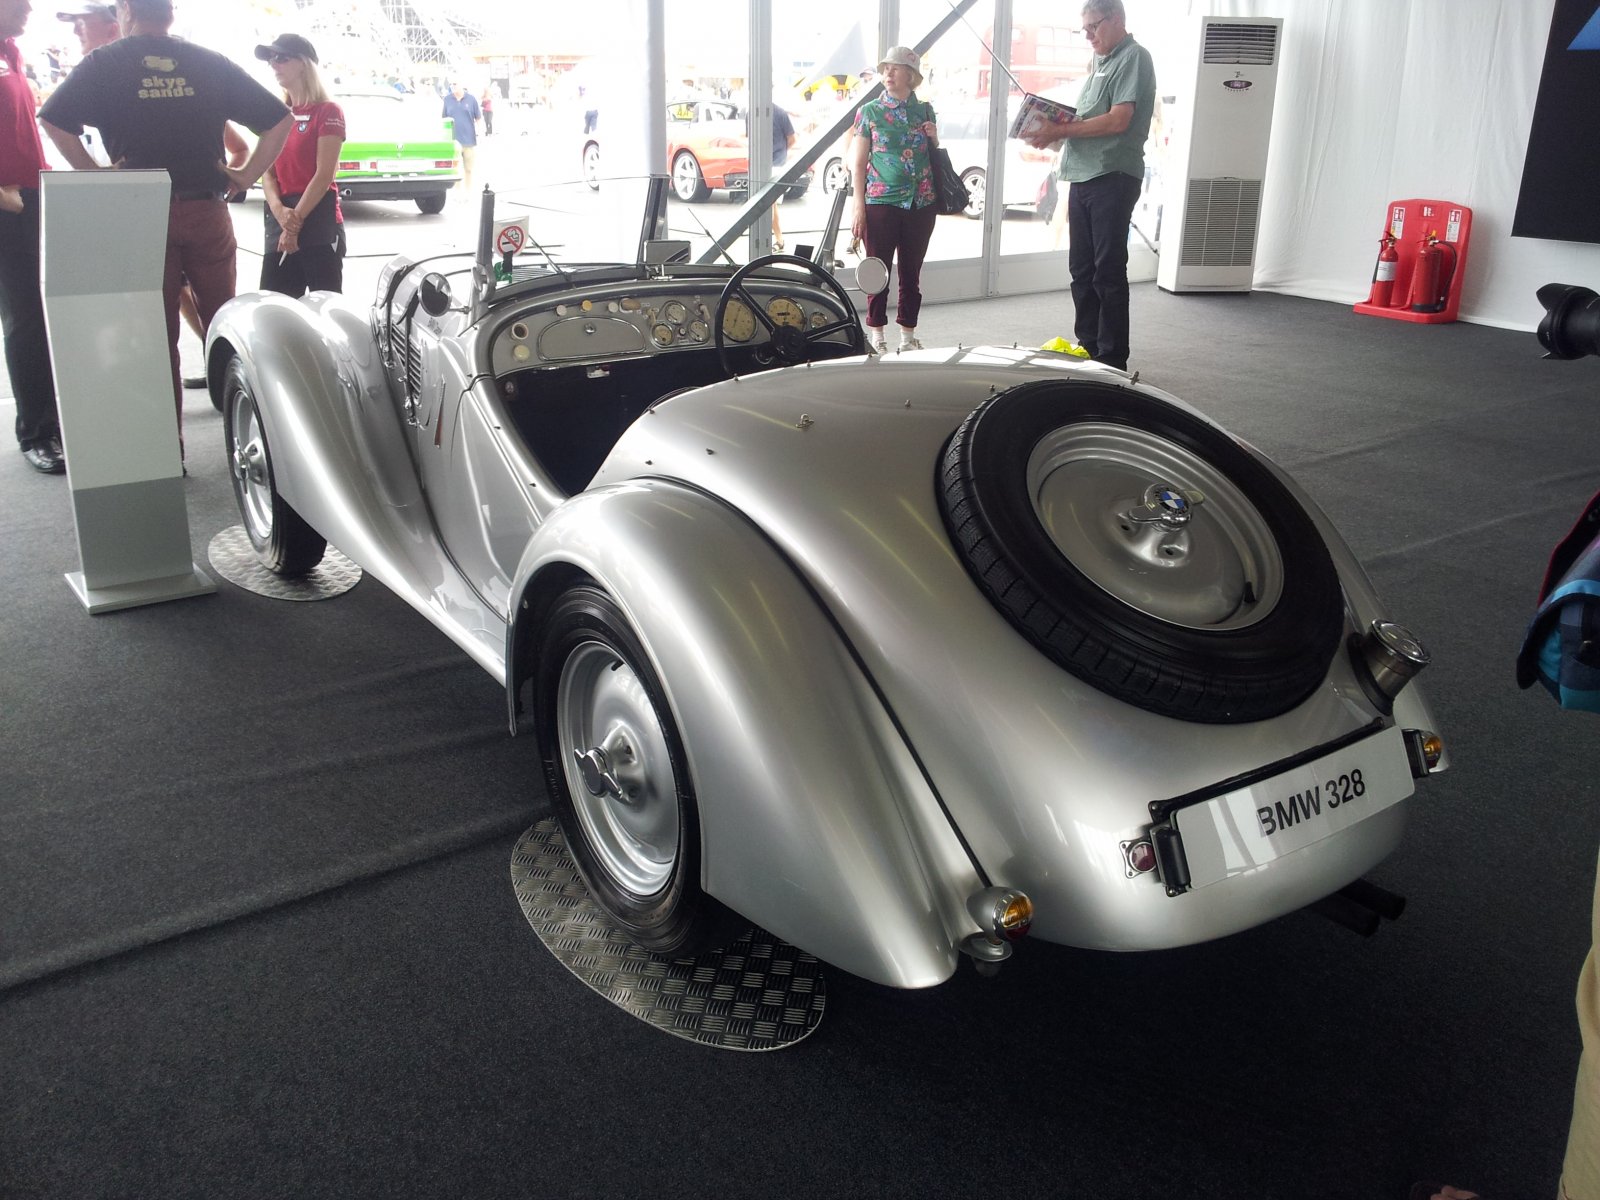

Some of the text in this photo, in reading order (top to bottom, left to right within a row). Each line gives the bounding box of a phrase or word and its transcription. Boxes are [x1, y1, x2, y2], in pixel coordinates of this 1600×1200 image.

[142, 76, 186, 89] skye
[138, 86, 195, 98] sands
[1257, 769, 1365, 836] BMW 328
